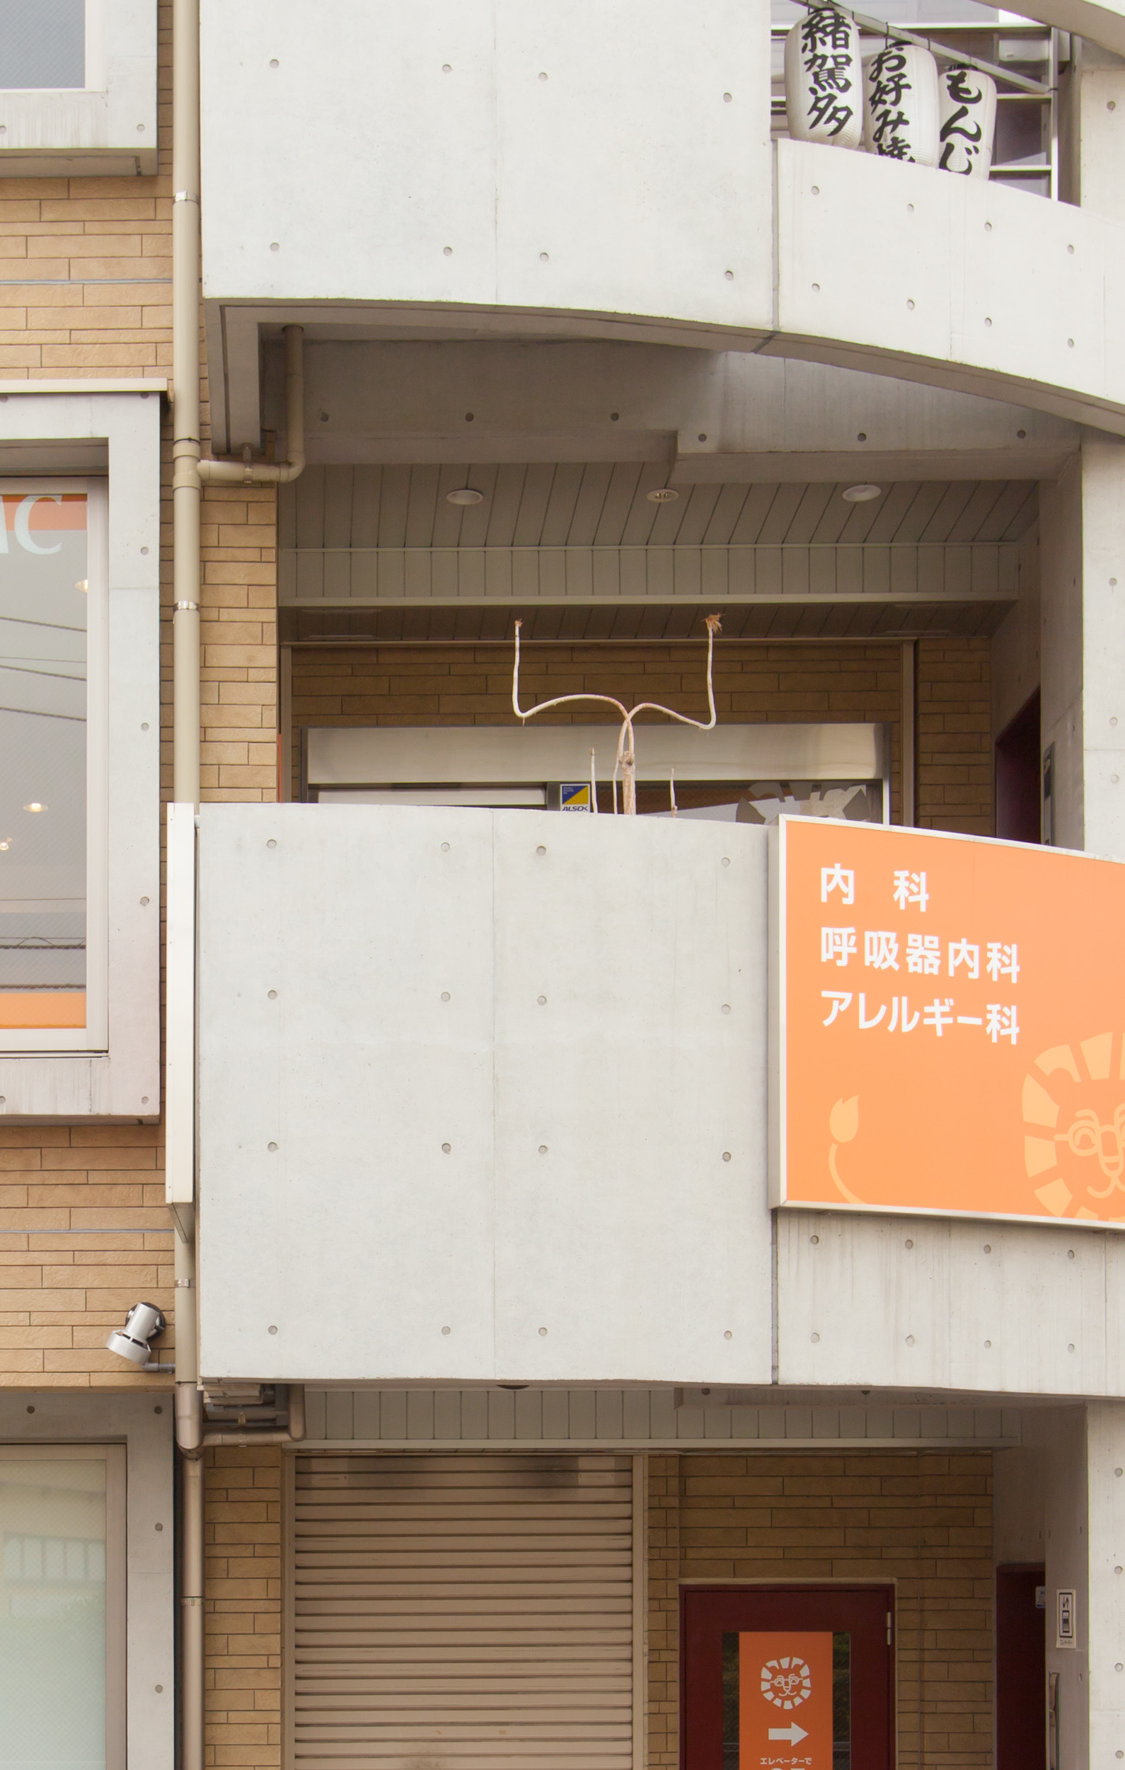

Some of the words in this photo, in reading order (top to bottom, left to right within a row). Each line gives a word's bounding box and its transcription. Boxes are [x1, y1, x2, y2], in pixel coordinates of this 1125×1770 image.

[820, 926, 1020, 983] 呼吸器内科
[820, 990, 1020, 1045] アレルギー科
[760, 1757, 812, 1765] エレベーターで
